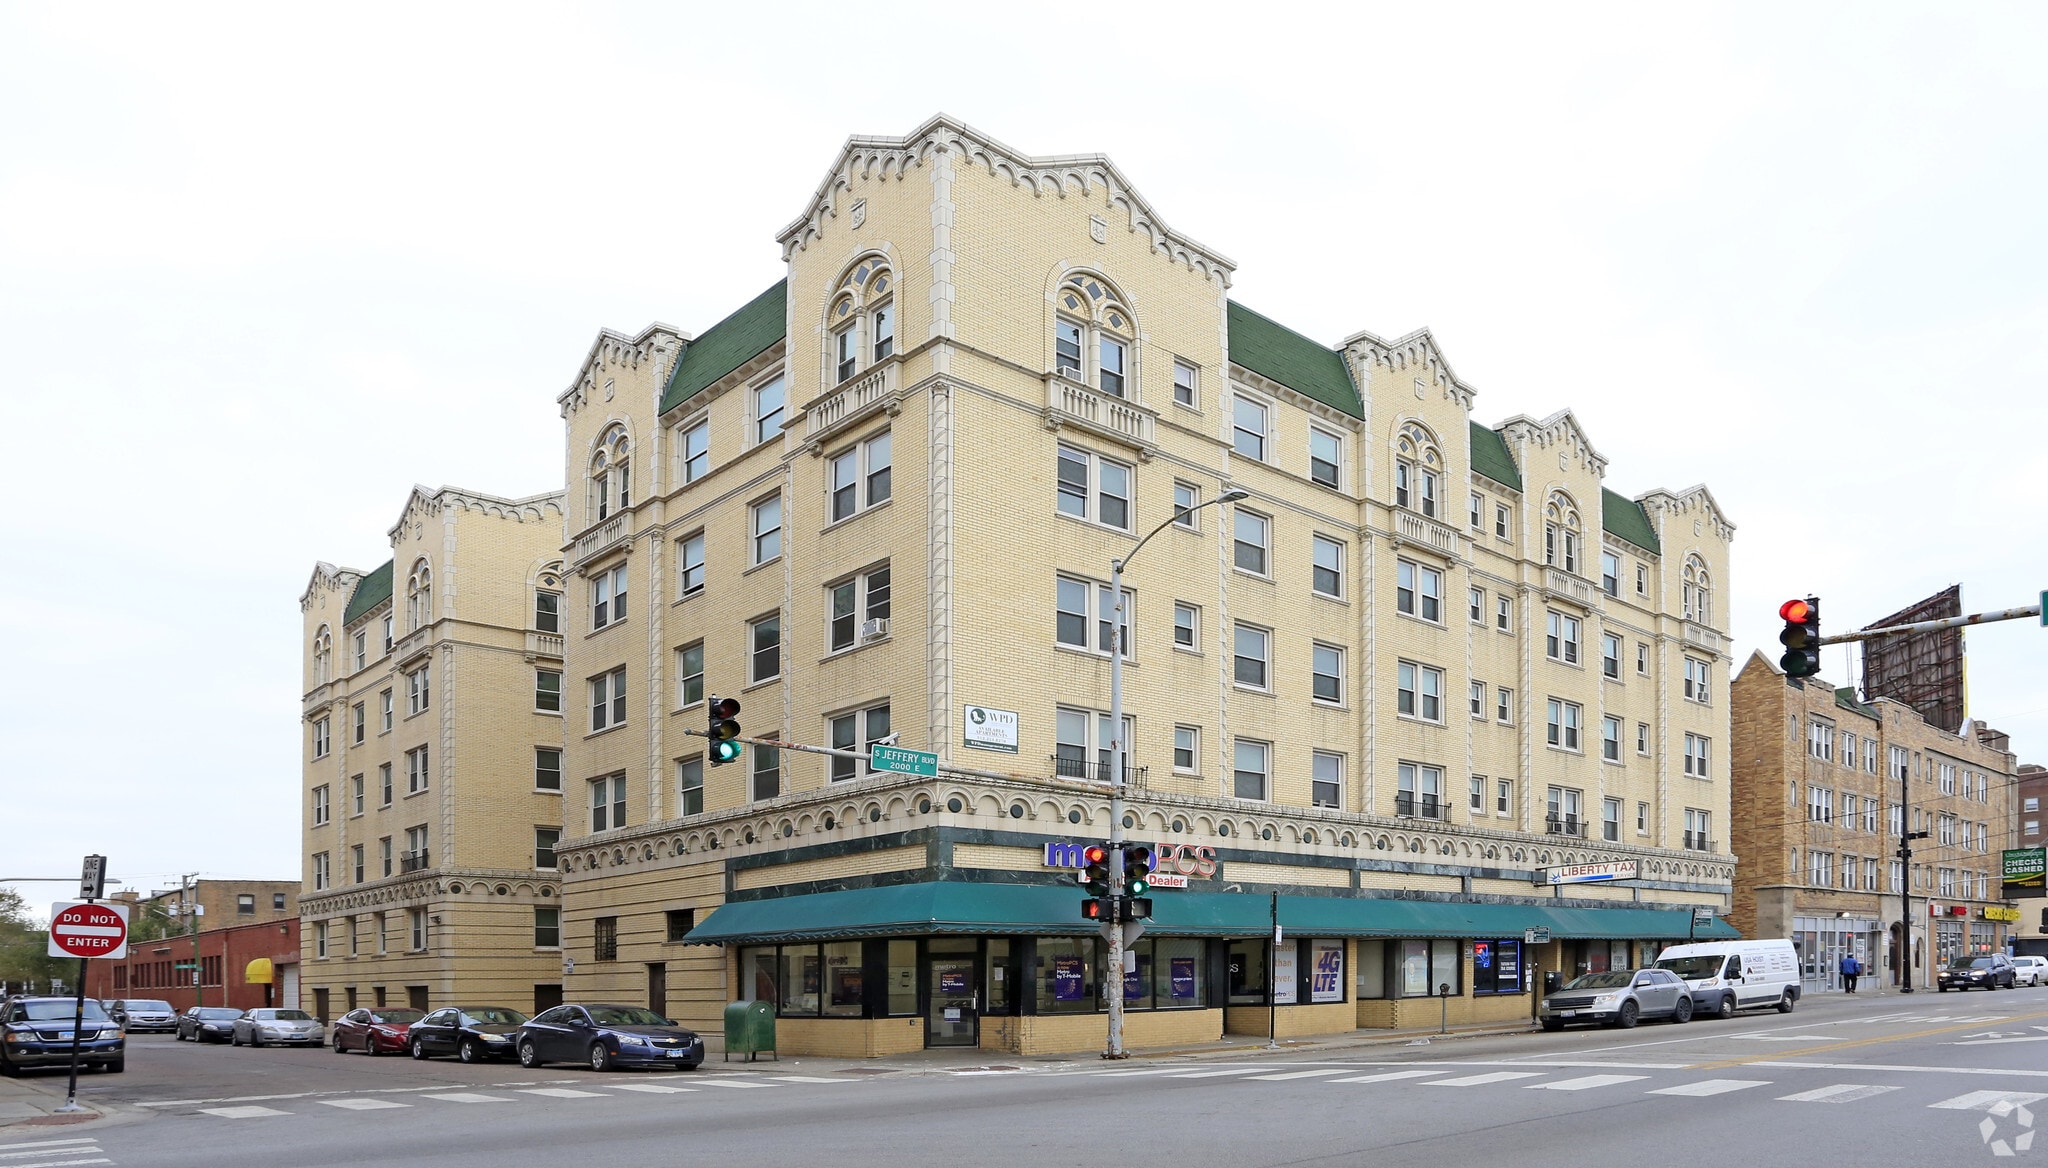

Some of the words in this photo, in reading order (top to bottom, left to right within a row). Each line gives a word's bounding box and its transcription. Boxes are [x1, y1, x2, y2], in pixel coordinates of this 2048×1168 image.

[989, 712, 1014, 724] WPD
[976, 729, 1008, 738] APARTMENTS
[978, 726, 1005, 734] AVAILABLE
[874, 749, 880, 757] S
[881, 749, 919, 763] JEFFERY
[921, 756, 936, 765] BLVD
[890, 761, 911, 771] 2000
[914, 764, 920, 772] E
[85, 859, 98, 870] ONE
[2005, 858, 2044, 867] CHECKS
[1561, 864, 1609, 877] LIBERTY
[1613, 861, 1636, 873] TAX
[2005, 865, 2044, 874] CASHED
[83, 871, 98, 881] WAY
[1149, 874, 1184, 887] Dealer
[63, 913, 81, 923] DO
[90, 914, 116, 924] NOT
[67, 937, 109, 947] ENTER
[1275, 944, 1296, 952] aster
[1318, 951, 1340, 973] 4G
[1313, 973, 1338, 992] LTE
